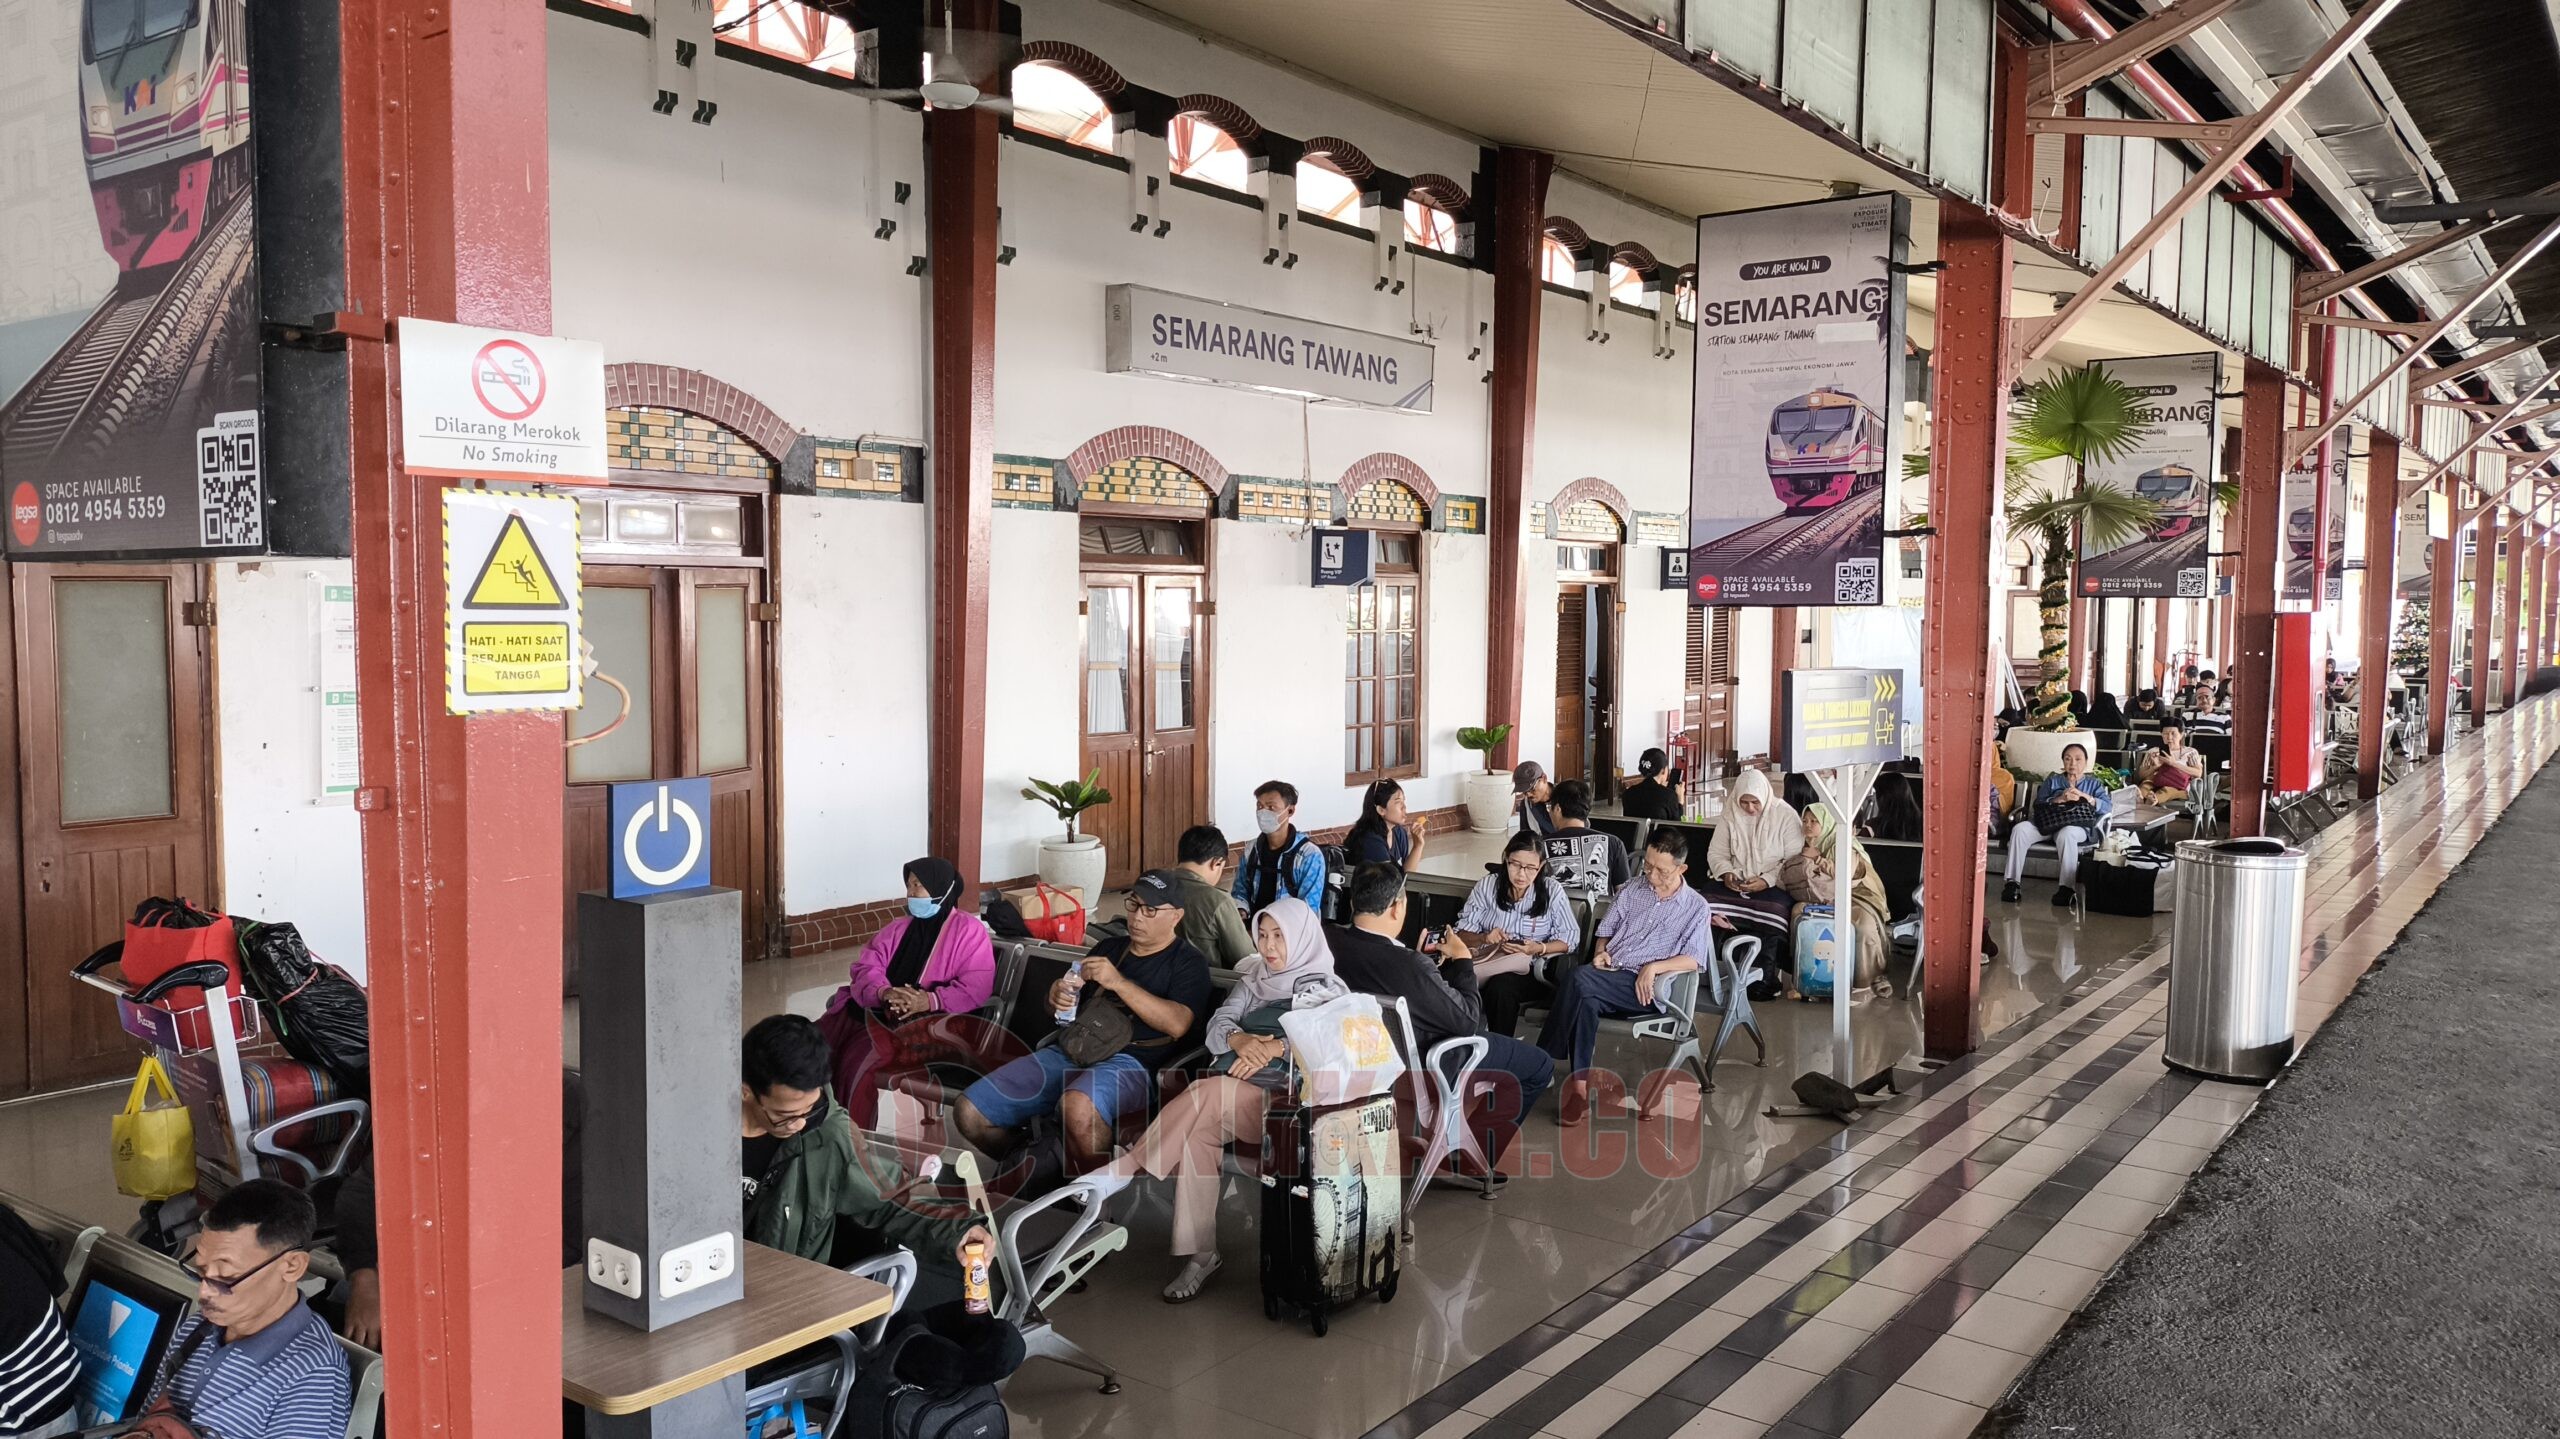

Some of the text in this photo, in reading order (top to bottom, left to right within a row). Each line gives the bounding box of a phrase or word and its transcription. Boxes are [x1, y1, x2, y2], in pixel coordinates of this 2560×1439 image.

[1851, 219, 1888, 229] ULTIMATE
[1753, 259, 1820, 278] YOU ARE NOW IN
[1704, 287, 1882, 327] SEMARANG
[1707, 328, 1816, 347] STATION SEMARANG TAWANG
[1152, 313, 1398, 385] SEMARANG TAWANG
[219, 421, 232, 430] SCAN
[435, 416, 581, 441] Dilarang Merokok
[463, 445, 558, 469] No Smoking
[45, 476, 142, 500] SPACE AVAILABLE
[46, 495, 166, 524] 0812 4954 5359
[1723, 583, 1812, 592] 0812 4954 5359
[1751, 575, 1796, 583] AVAILABLE
[469, 637, 496, 646] HATI
[506, 637, 532, 646] HATI
[535, 636, 563, 646] SAAT
[471, 653, 562, 663] BERJALAN PADA
[495, 670, 541, 680] TANGGA
